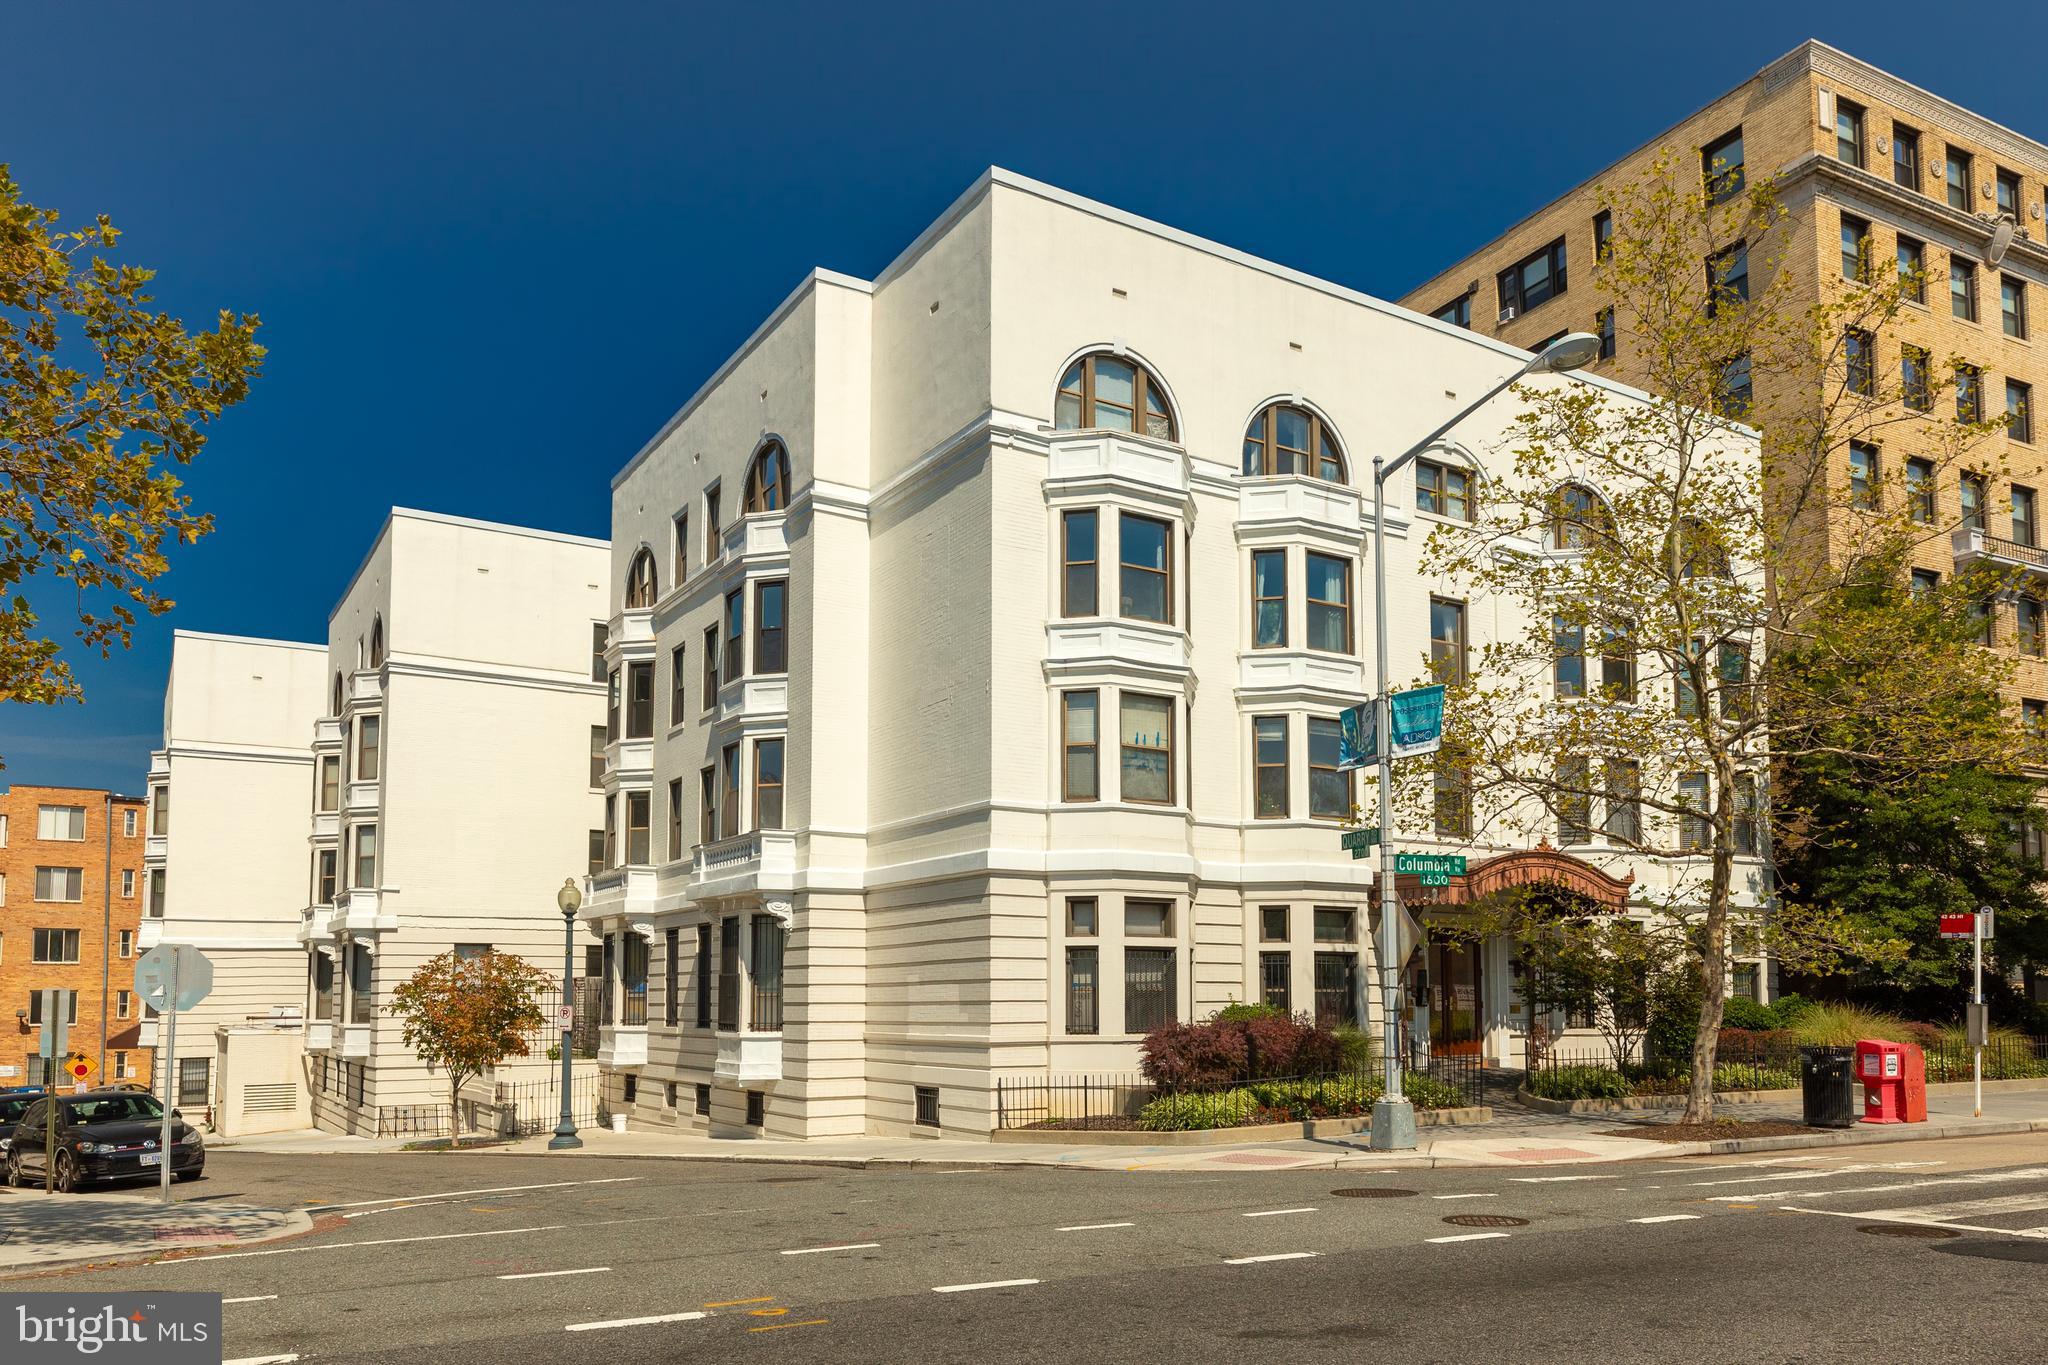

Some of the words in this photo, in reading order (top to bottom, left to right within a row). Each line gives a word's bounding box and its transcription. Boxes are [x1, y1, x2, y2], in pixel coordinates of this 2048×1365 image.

[1342, 831, 1370, 849] QUARRY
[1398, 857, 1450, 872] Columbia
[1422, 875, 1448, 885] 1600
